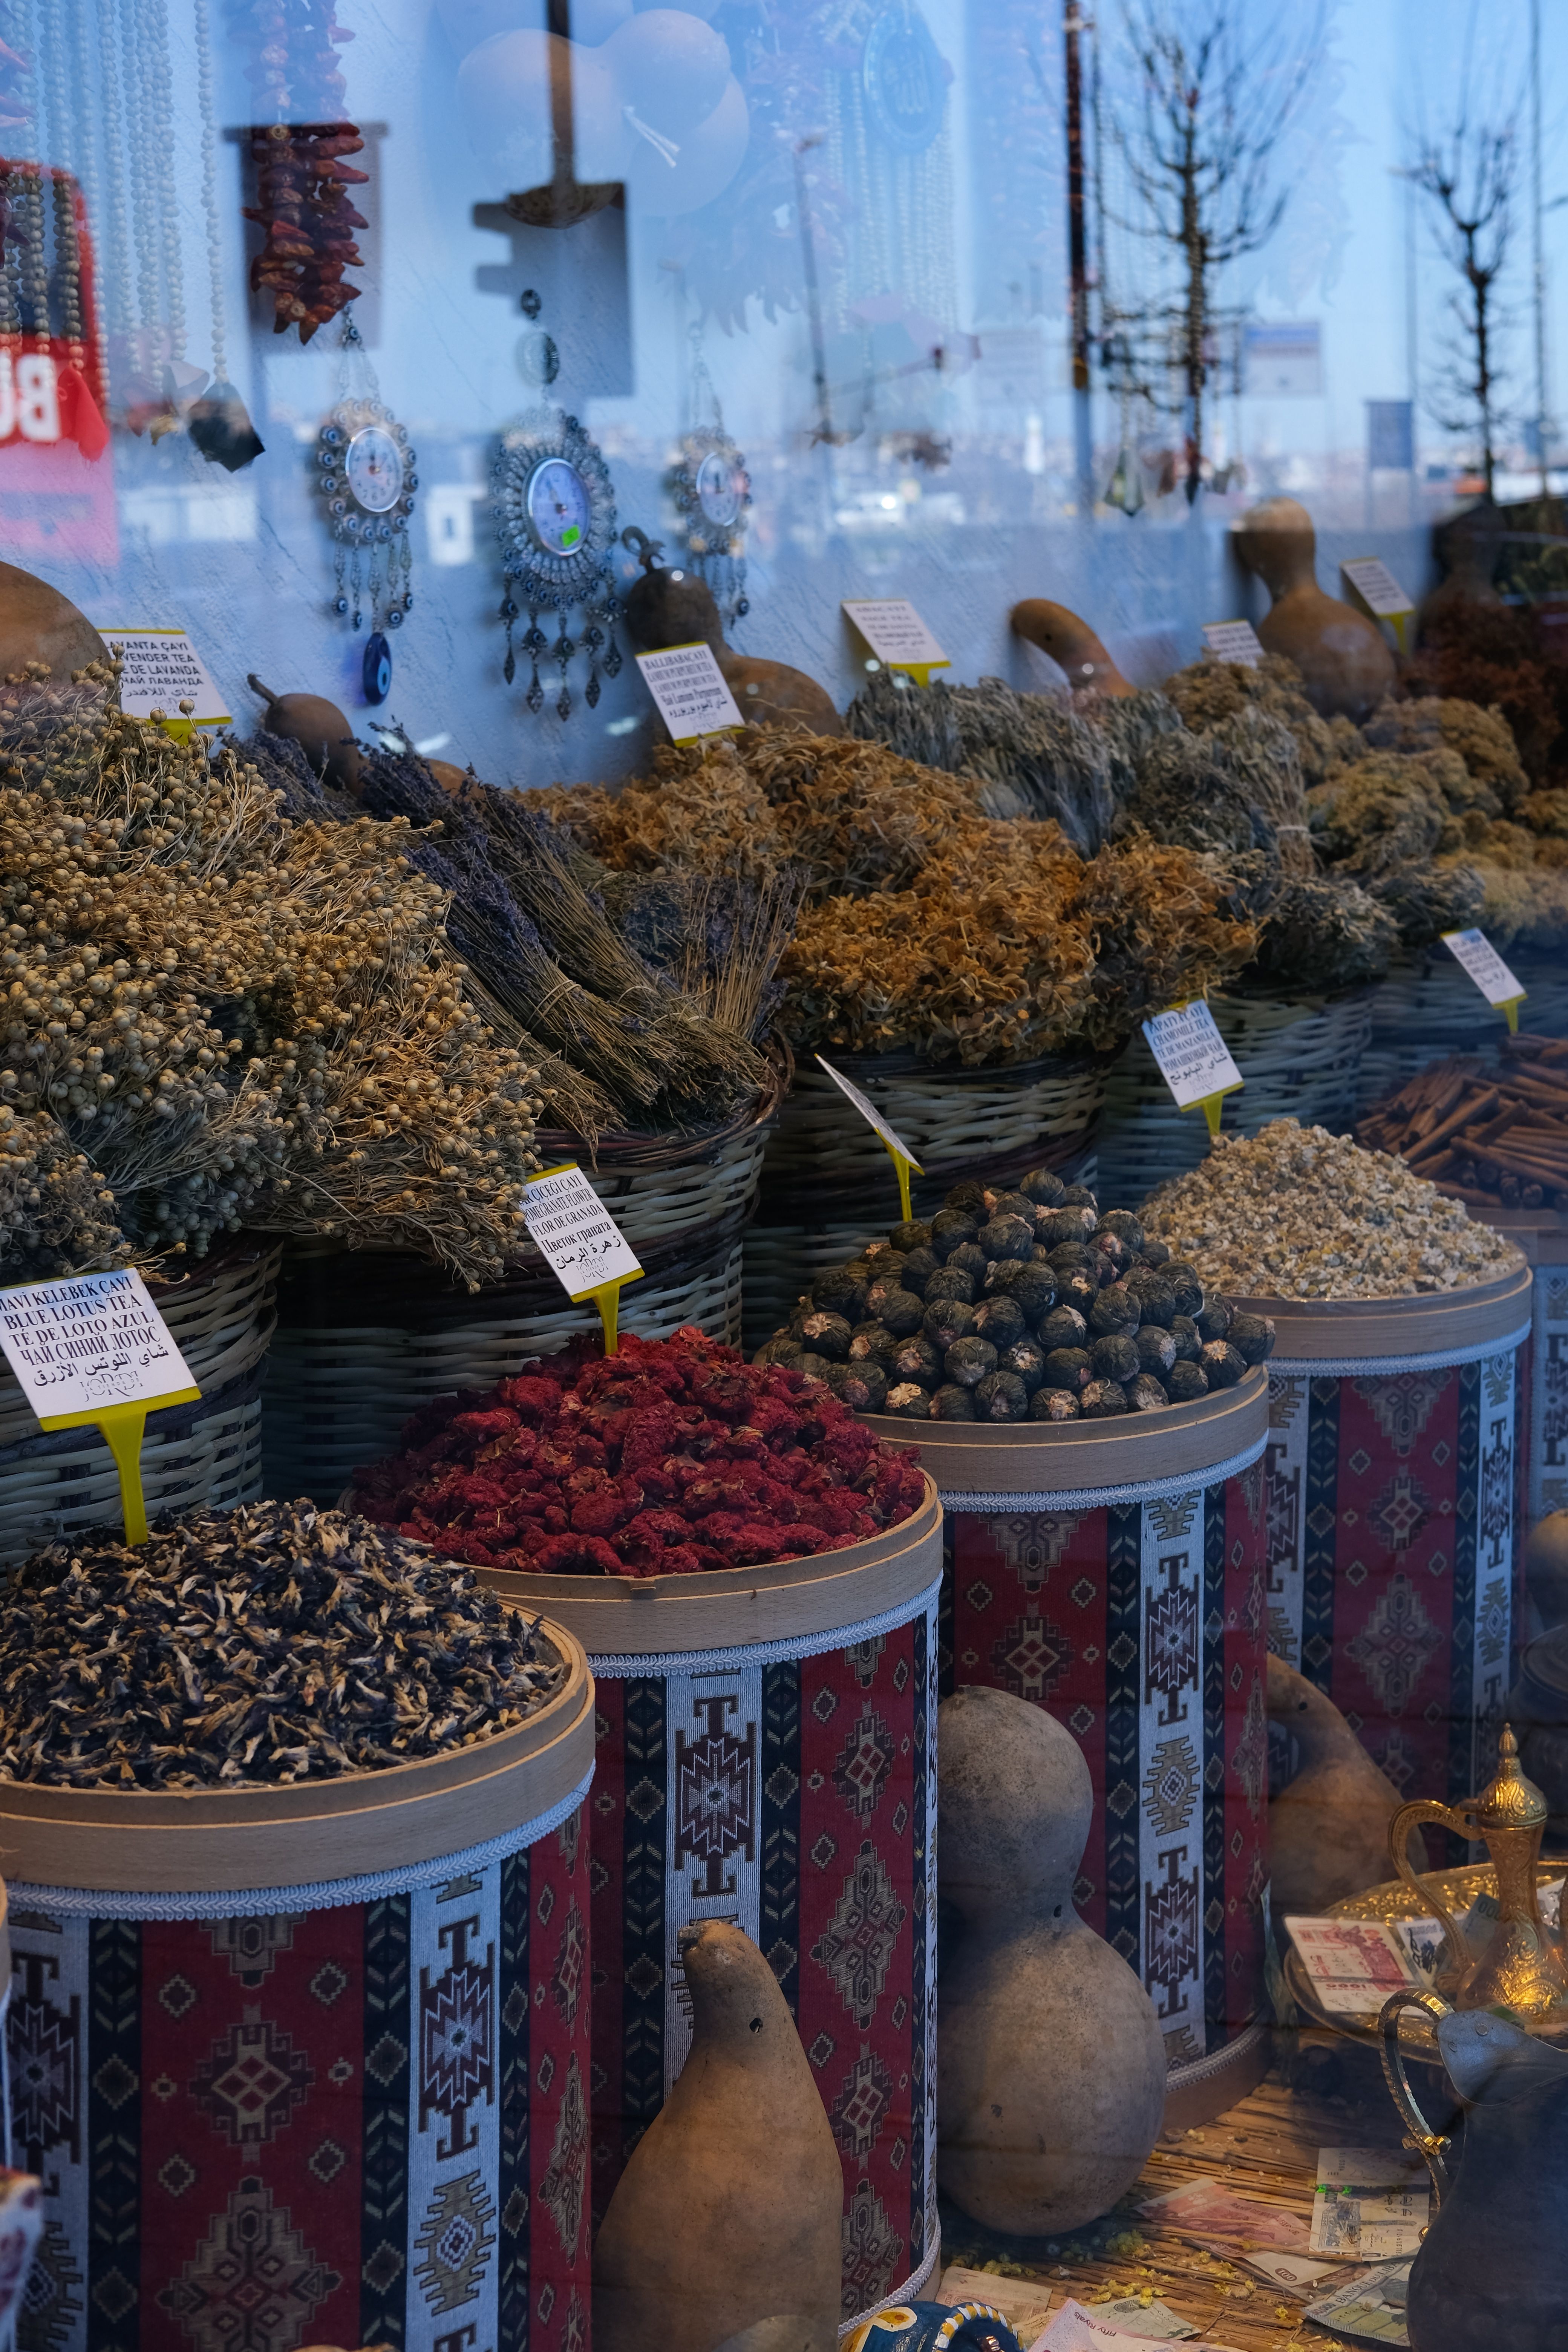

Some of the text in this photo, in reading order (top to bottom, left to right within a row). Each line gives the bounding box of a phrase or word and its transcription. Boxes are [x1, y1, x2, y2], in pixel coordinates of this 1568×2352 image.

[161, 642, 188, 652] ÇAYI
[171, 654, 196, 663] TEA
[130, 665, 145, 674] DE
[147, 665, 201, 675] LAVANDA
[149, 677, 204, 686] ЛАВАНДА
[1153, 1018, 1210, 1047] CHAMOMILE TEA
[1174, 1031, 1216, 1051] MANZANILLA
[531, 1179, 561, 1201] ÇİÇEĞİ
[560, 1174, 583, 1192] ÇAYI
[523, 1188, 594, 1222] POMEGRANATE FLOWER
[532, 1203, 604, 1237] FLOR DE GRANADA
[541, 1221, 612, 1255] Цветок граната
[556, 1235, 621, 1269] زهرة الرمان
[31, 1283, 100, 1305] KELEBEK
[99, 1276, 133, 1297] ÇAYI
[3, 1294, 143, 1330] BLUE LOTUS TEA
[9, 1311, 155, 1348] TÉ DE LOTO AZUL
[19, 1326, 161, 1366] ЧАЙ СИНИЙ ЛОТОС
[34, 1344, 169, 1387] شاي اللوتس الأزرق
[98, 1380, 126, 1390] TIENDA
[1277, 2268, 1297, 2281] 100
[1369, 2276, 1382, 2288] DU
